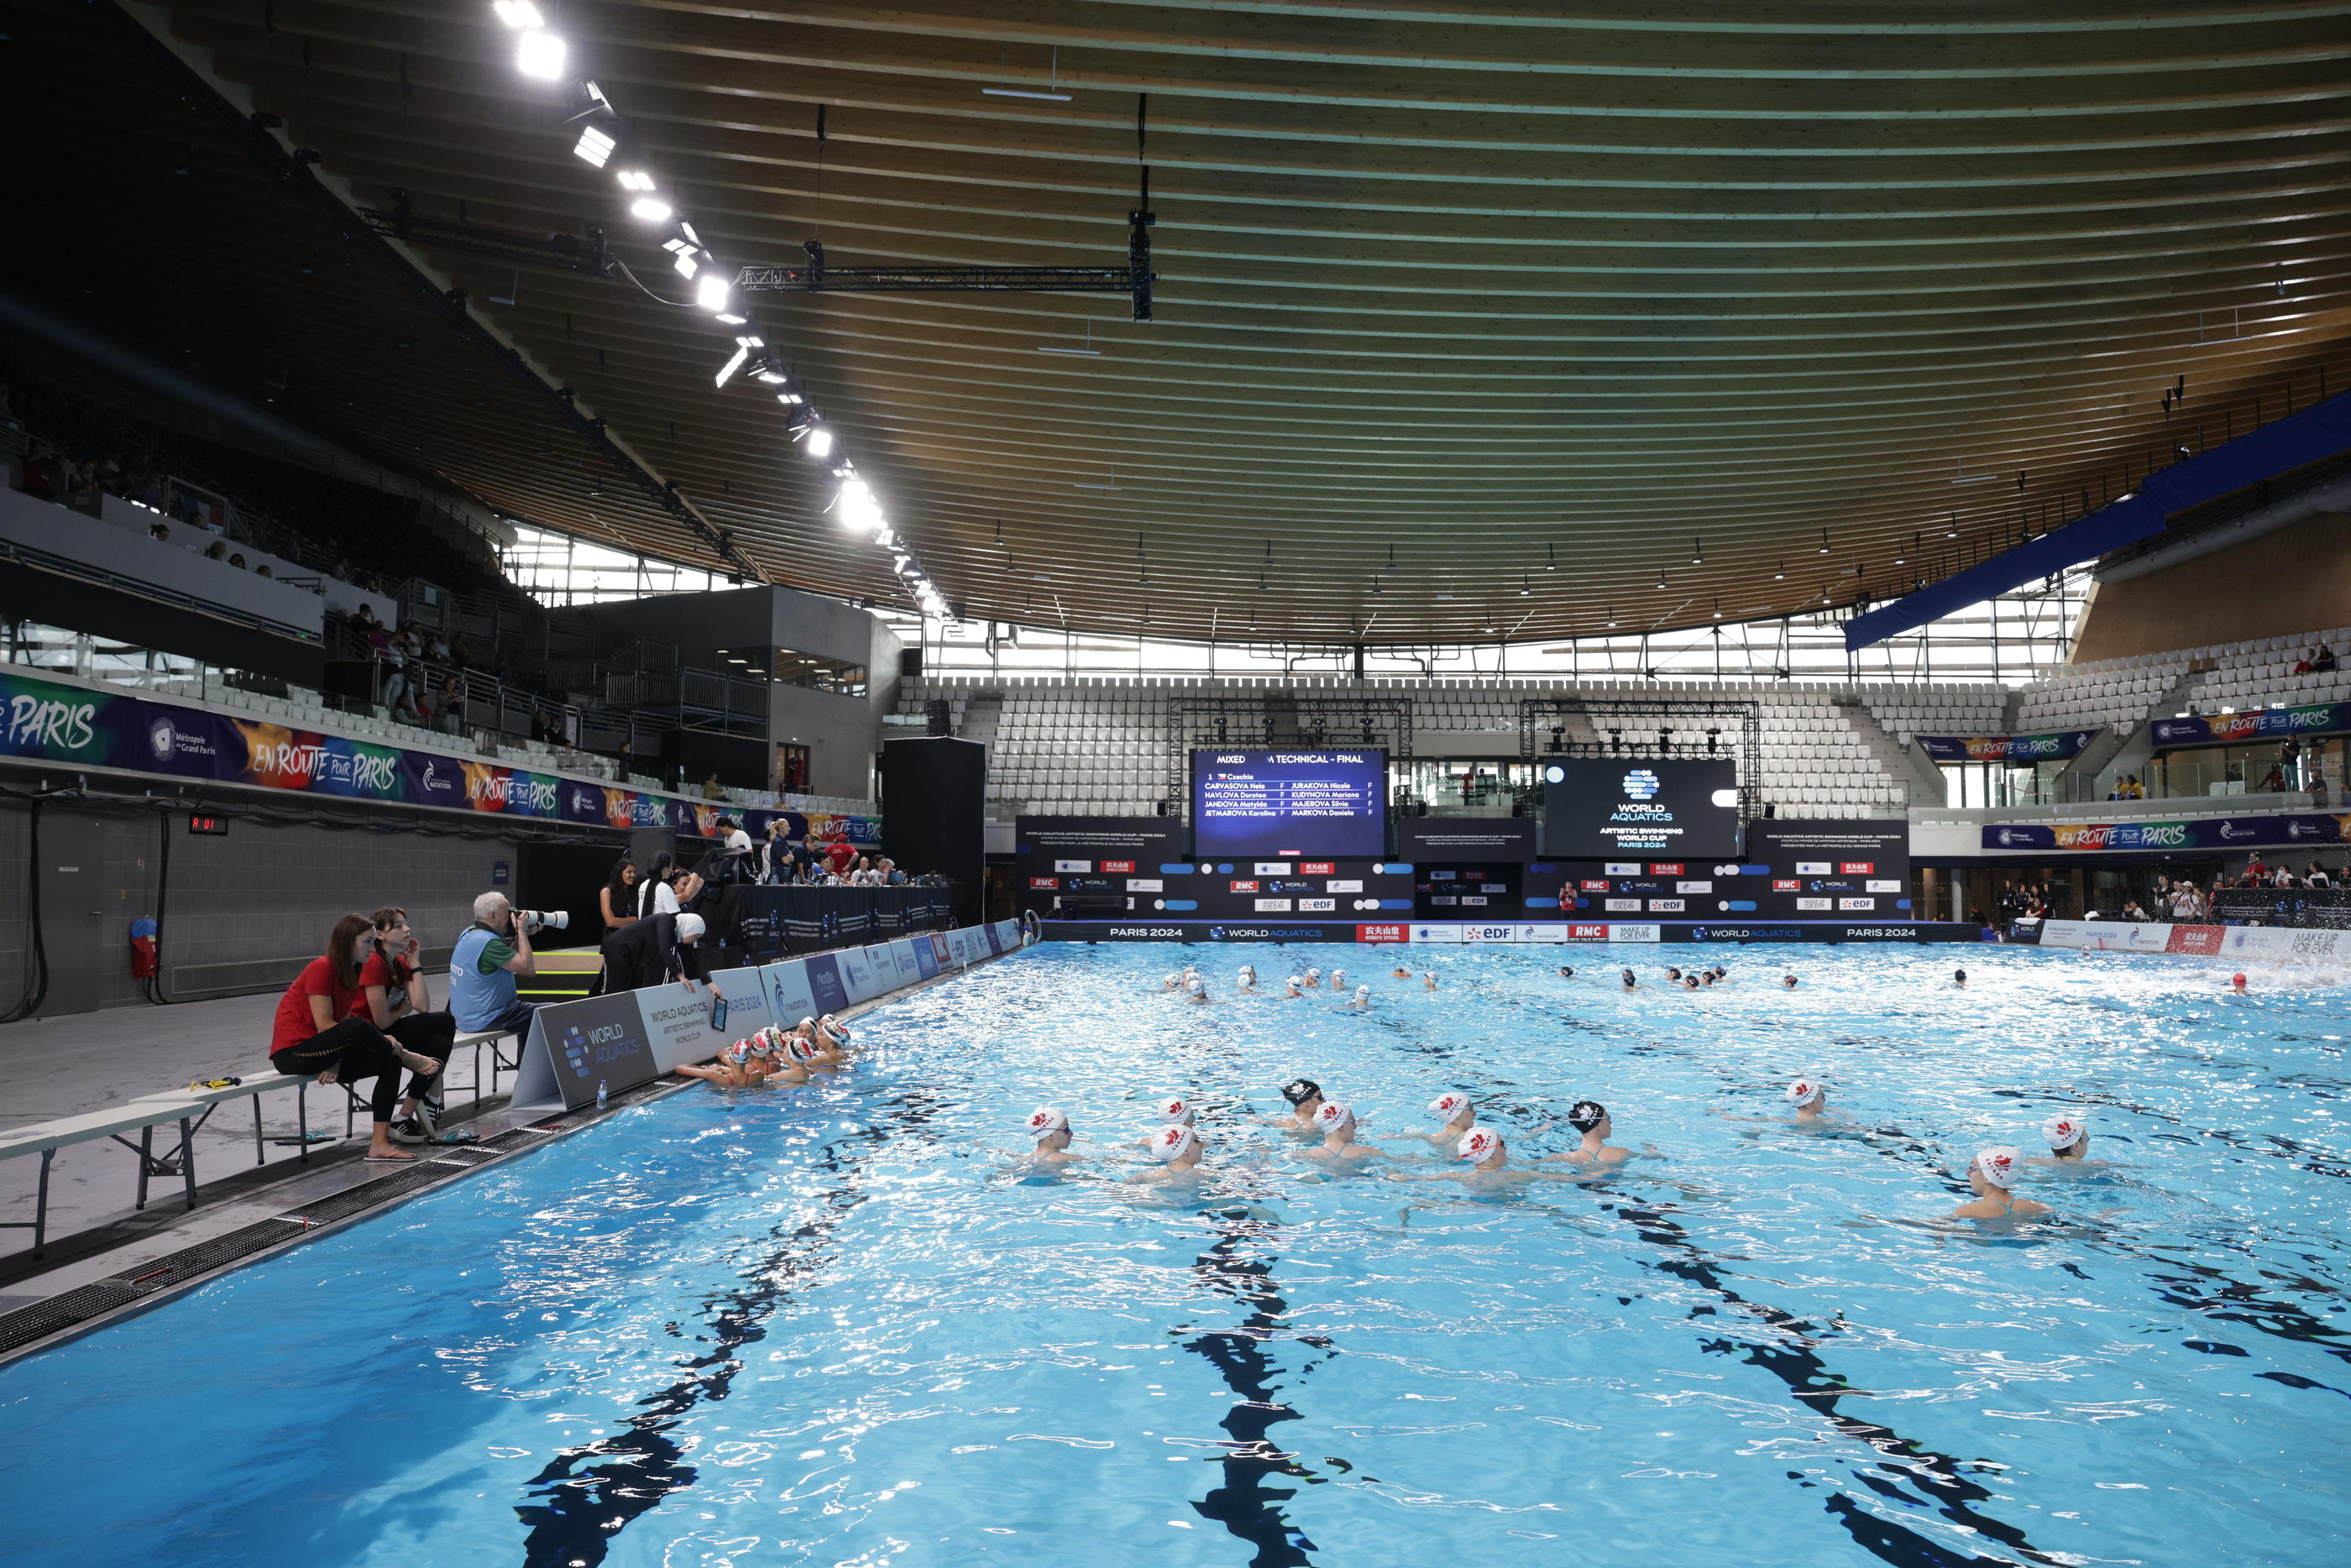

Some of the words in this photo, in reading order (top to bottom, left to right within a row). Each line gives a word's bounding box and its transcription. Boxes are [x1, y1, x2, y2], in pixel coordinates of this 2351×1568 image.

[8, 695, 95, 749] PARIS
[2215, 723, 2228, 733] EN
[2230, 716, 2267, 732] ROUTE
[2270, 718, 2286, 726] POUR
[2289, 709, 2329, 727] PARIS
[175, 733, 205, 745] Métropole
[181, 744, 199, 753] Grand
[199, 746, 215, 755] Paris
[1970, 745, 1981, 754] EN
[1984, 741, 2014, 754] ROUTE
[2030, 739, 2059, 754] PARIS
[253, 745, 275, 773] EN
[277, 742, 330, 781] ROUTE
[331, 759, 350, 776] POUR
[352, 753, 396, 790] PARIS
[471, 777, 484, 799] EN
[483, 776, 516, 805] ROUTE
[529, 781, 556, 810] PARIS
[1618, 804, 1665, 812] WORLD
[1610, 813, 1673, 821] AQUATICS
[812, 822, 823, 834] EN
[825, 820, 851, 836] ROUTE
[2060, 832, 2073, 845] EN
[2077, 828, 2117, 846] ROUTE
[2121, 832, 2139, 841] POUR
[2142, 825, 2185, 845] PARIS
[1110, 928, 1147, 937] PARIS
[1150, 928, 1182, 937] 2024
[1365, 926, 1399, 935] 农夫山泉
[1484, 928, 1510, 938] eDF
[1576, 926, 1601, 936] RMC
[1847, 928, 1882, 937] PARIS
[1885, 928, 1916, 937] 2024
[2295, 933, 2322, 943] MAKE
[2325, 933, 2339, 943] UP
[2291, 943, 2309, 953] FOR
[2312, 944, 2334, 954] EVER
[728, 999, 745, 1014] PARIS
[746, 996, 762, 1010] 2024
[785, 999, 809, 1013] FFNATATION
[651, 1009, 675, 1023] WORLD
[677, 1002, 708, 1018] AQUATICS
[663, 1024, 683, 1034] ARTISTIC
[684, 1019, 705, 1030] SWIMMING
[588, 1024, 623, 1045] WORLD
[675, 1035, 691, 1045] WORLD
[691, 1033, 701, 1043] CUP
[596, 1039, 639, 1064] AQUATICS
[1172, 1131, 1187, 1151] CANADA
